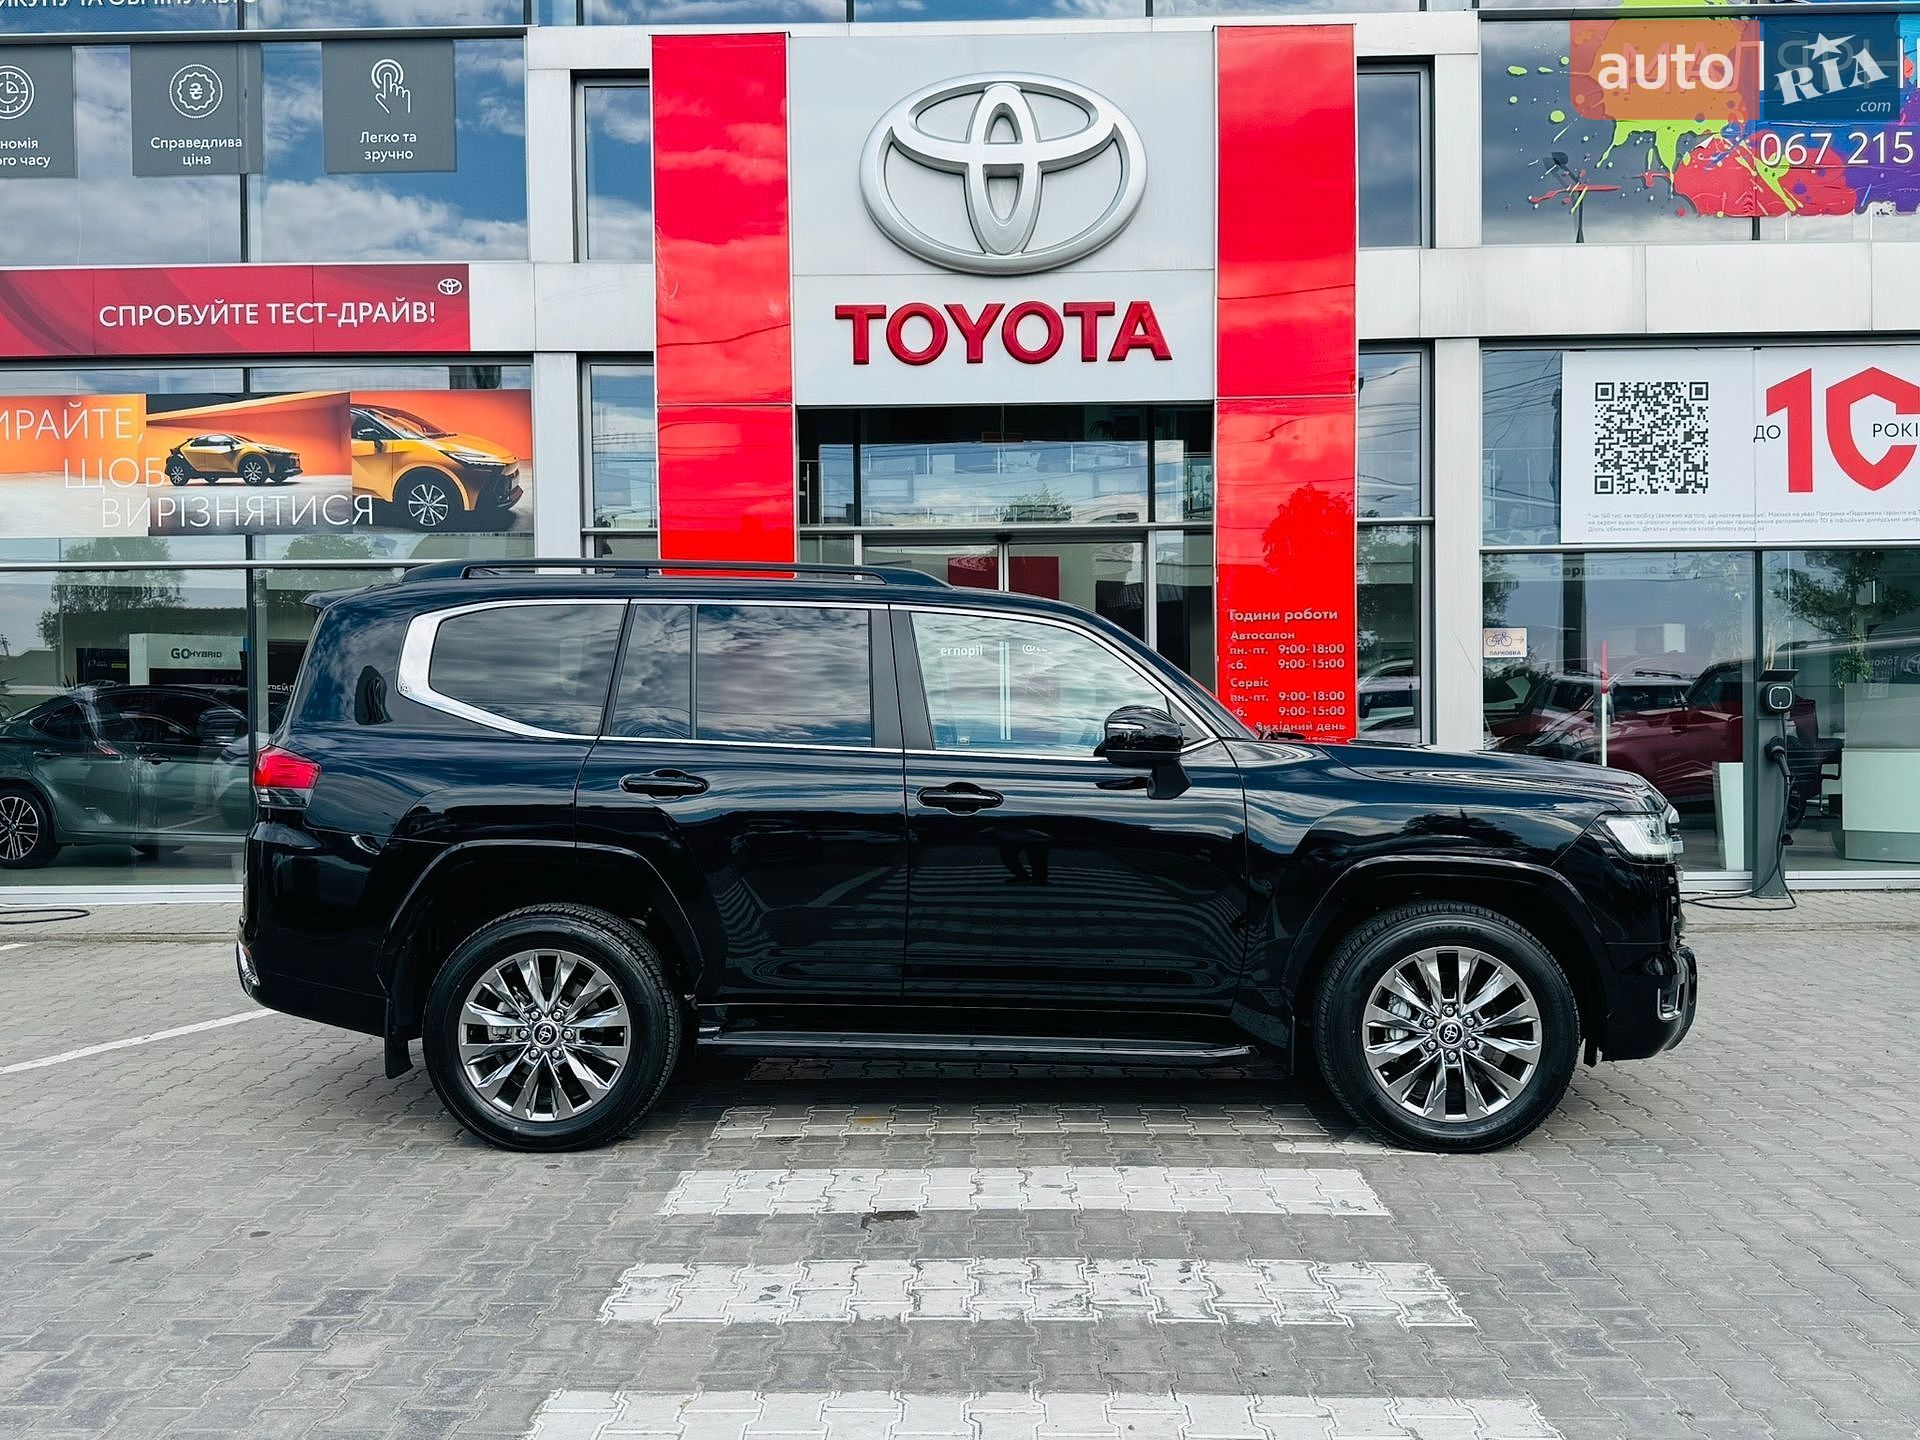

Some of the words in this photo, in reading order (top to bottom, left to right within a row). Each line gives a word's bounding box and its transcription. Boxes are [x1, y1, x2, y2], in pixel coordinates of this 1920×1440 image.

[150, 136, 242, 151] Справедлива
[360, 131, 399, 146] Легко
[402, 132, 417, 144] та
[364, 149, 414, 163] зручно
[1760, 132, 1833, 166] 067
[1847, 131, 1915, 164] 215
[20, 156, 51, 168] часу
[182, 154, 212, 167] ціна
[99, 299, 258, 327] СПРОБУЙТЕ
[266, 295, 436, 327] ТЕСТ-ДРАЙВ!
[834, 300, 1173, 366] TOYOTA
[1753, 424, 1782, 443] ДО
[65, 457, 165, 495] ЩОБ
[102, 494, 374, 530] ВИРІЗНЯТИСЯ
[1229, 609, 1280, 622] Години
[1284, 608, 1337, 623] роботи
[1230, 630, 1295, 640] Автосалон
[1229, 660, 1247, 670] сб.
[1230, 677, 1270, 689] Сервіс
[1316, 722, 1346, 733] день
